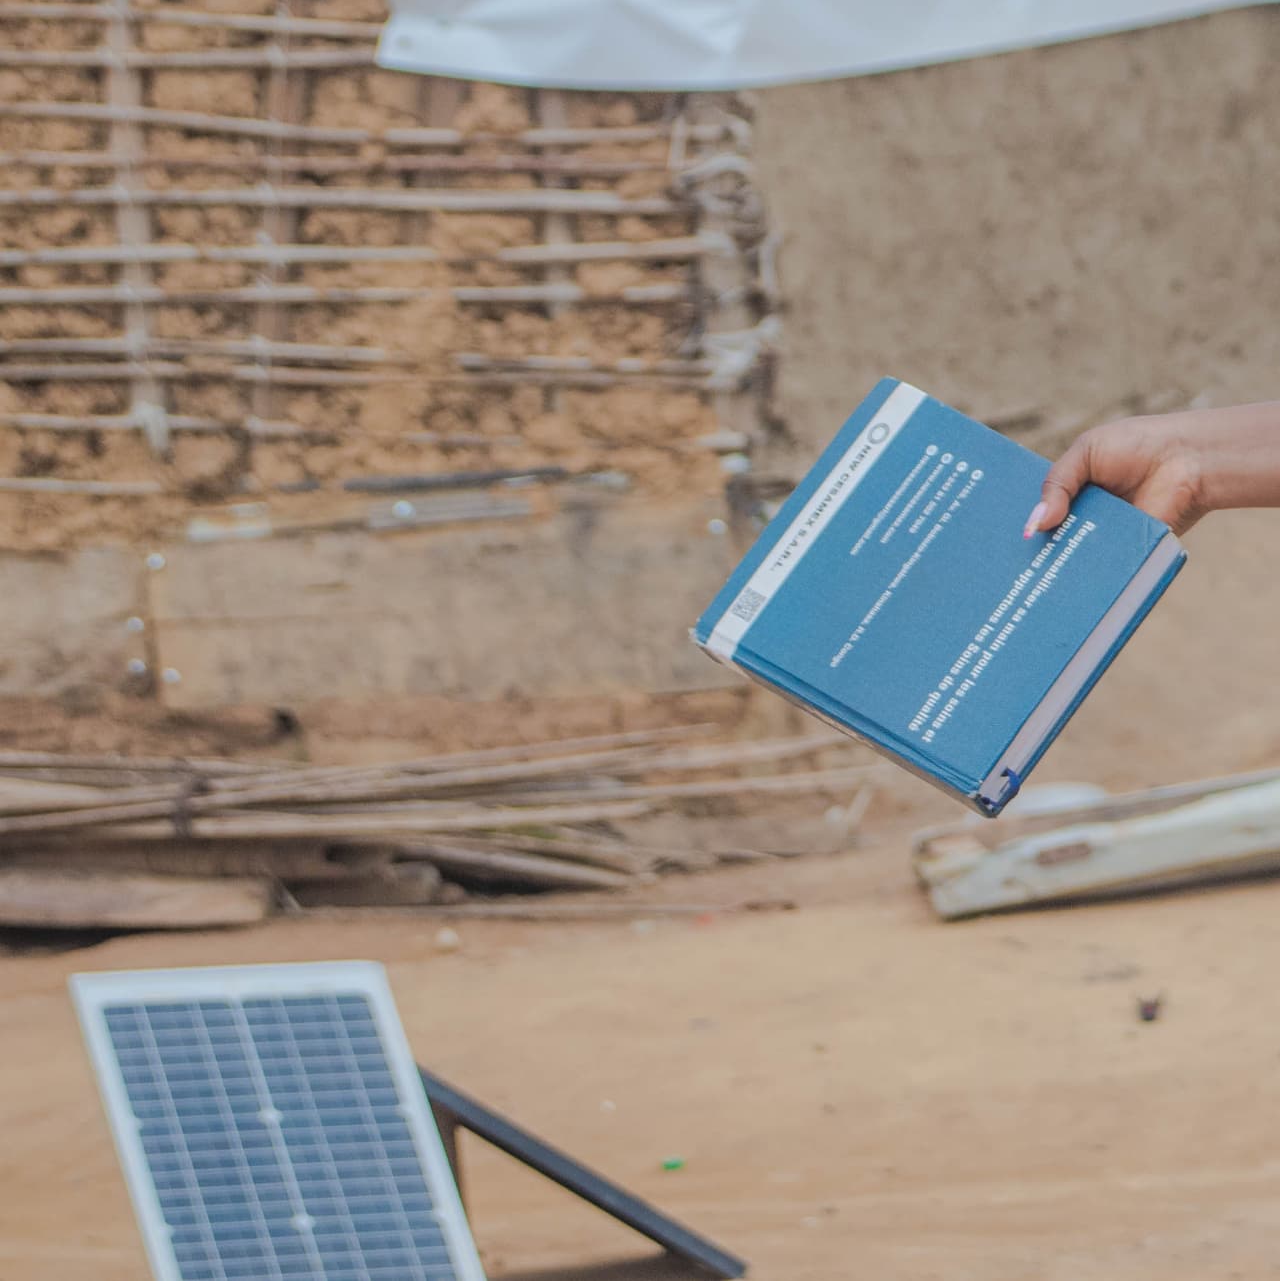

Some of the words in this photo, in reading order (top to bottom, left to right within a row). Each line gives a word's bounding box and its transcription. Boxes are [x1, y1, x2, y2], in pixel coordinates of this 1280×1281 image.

[849, 444, 871, 471] NEW
[1052, 514, 1077, 541] nous
[1023, 520, 1096, 607] Responsabiliser
[1030, 542, 1055, 568] vous
[988, 568, 1034, 623] apportons
[974, 623, 994, 642] les
[989, 622, 1015, 651] main
[949, 642, 980, 674] Soins
[970, 650, 992, 678] pour
[938, 675, 953, 690] de
[954, 678, 975, 697] les
[931, 697, 958, 728] soins
[921, 729, 935, 742] et
